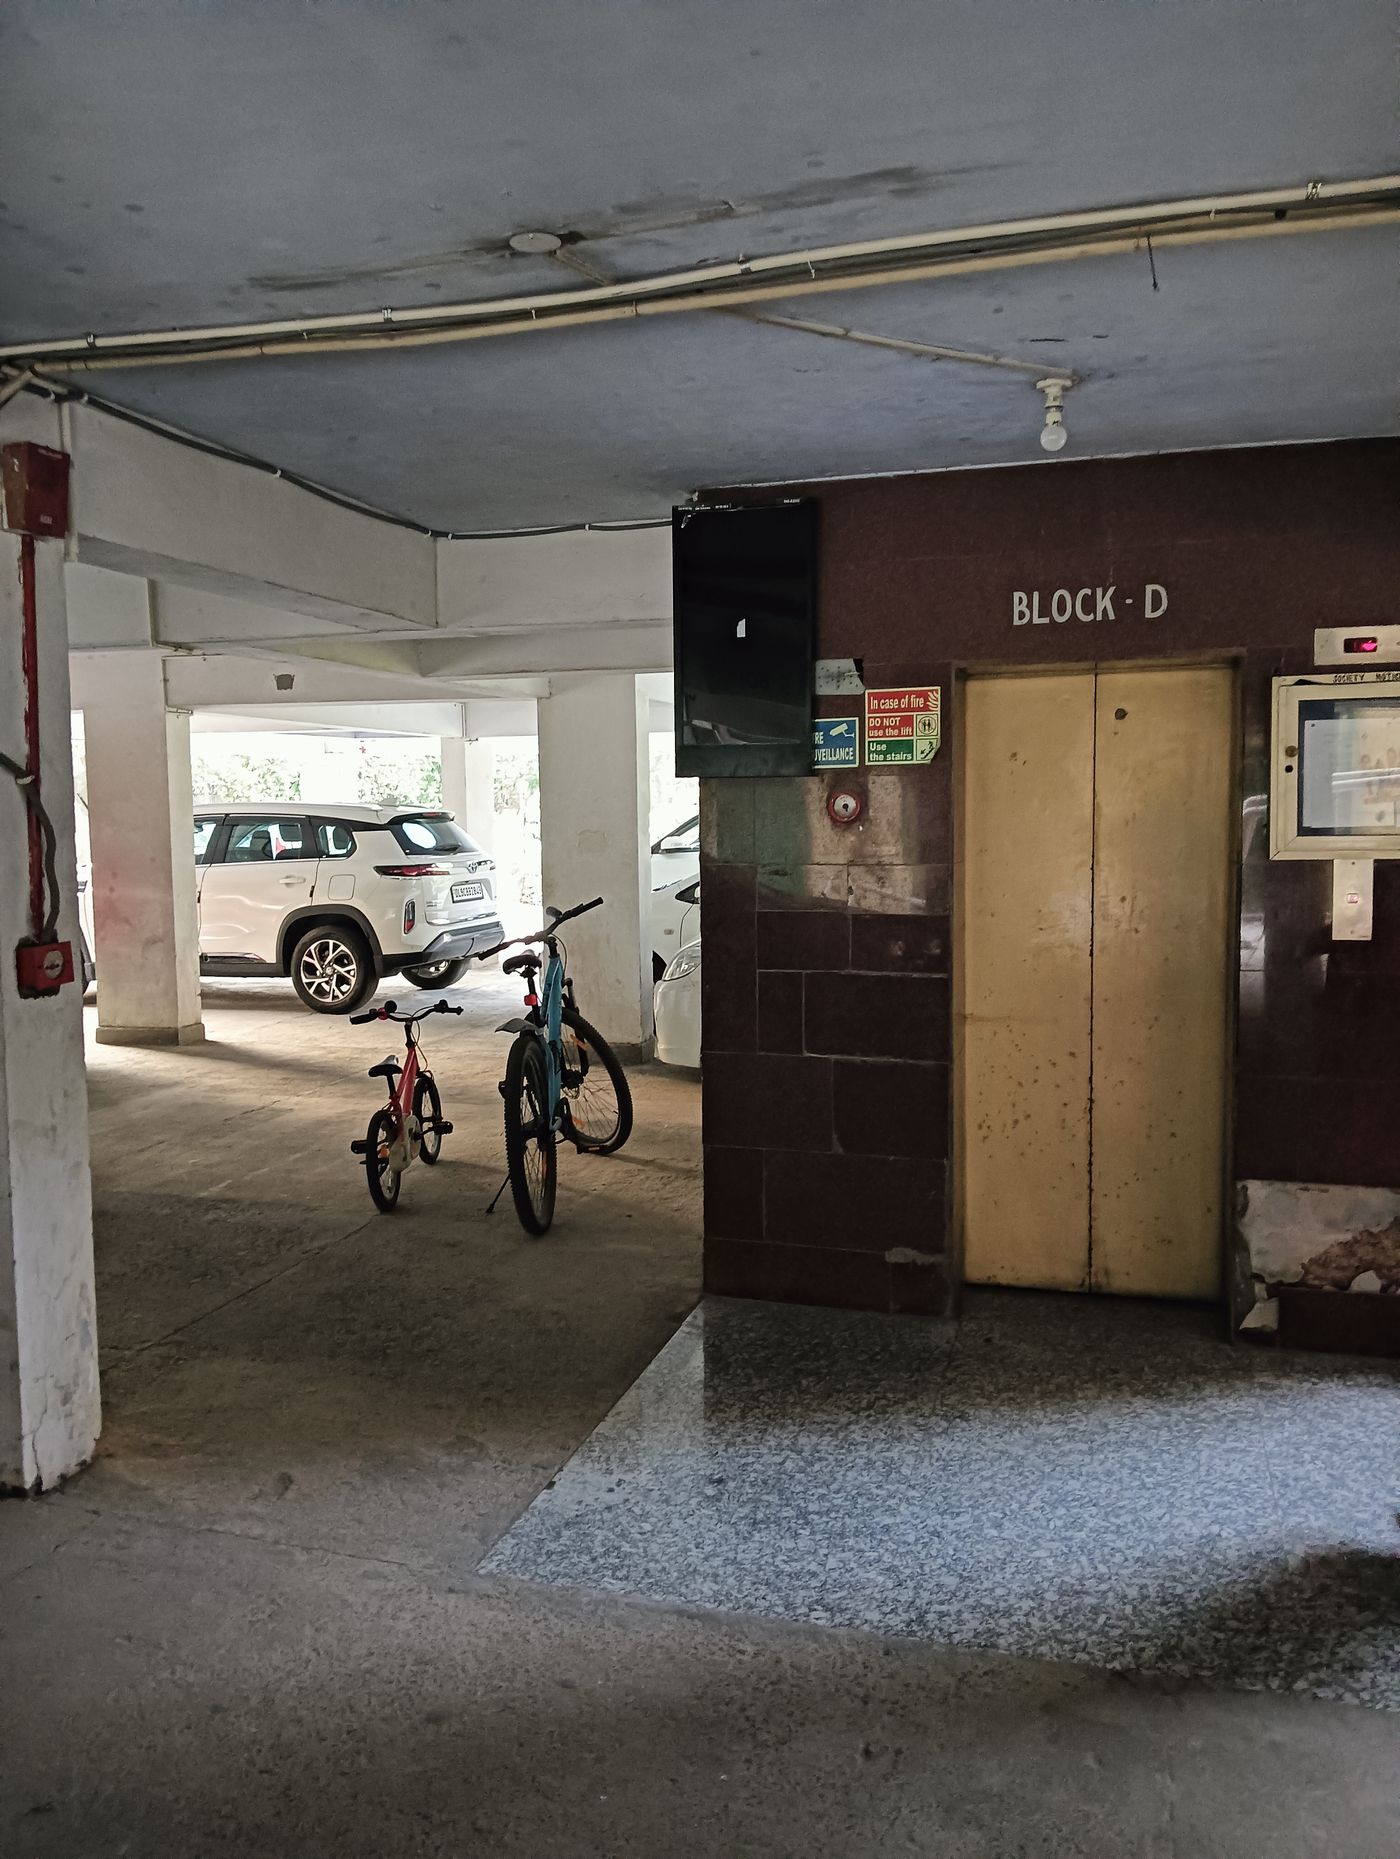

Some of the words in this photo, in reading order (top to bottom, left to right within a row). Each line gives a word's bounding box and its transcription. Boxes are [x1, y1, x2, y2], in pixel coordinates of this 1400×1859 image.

[1012, 585, 1117, 626] BLOCK
[1144, 583, 1169, 619] D
[1333, 673, 1365, 683] SOCIETY
[870, 696, 878, 710] In
[880, 699, 899, 709] case
[900, 695, 909, 708] of
[910, 695, 925, 708] fire
[869, 718, 881, 727] DO
[883, 717, 901, 726] NOT
[869, 729, 883, 737] use
[885, 727, 898, 736] the
[901, 726, 913, 736] lift
[813, 732, 824, 745] RE
[869, 743, 887, 751] Use
[869, 753, 884, 761] the
[886, 752, 912, 761] stairs
